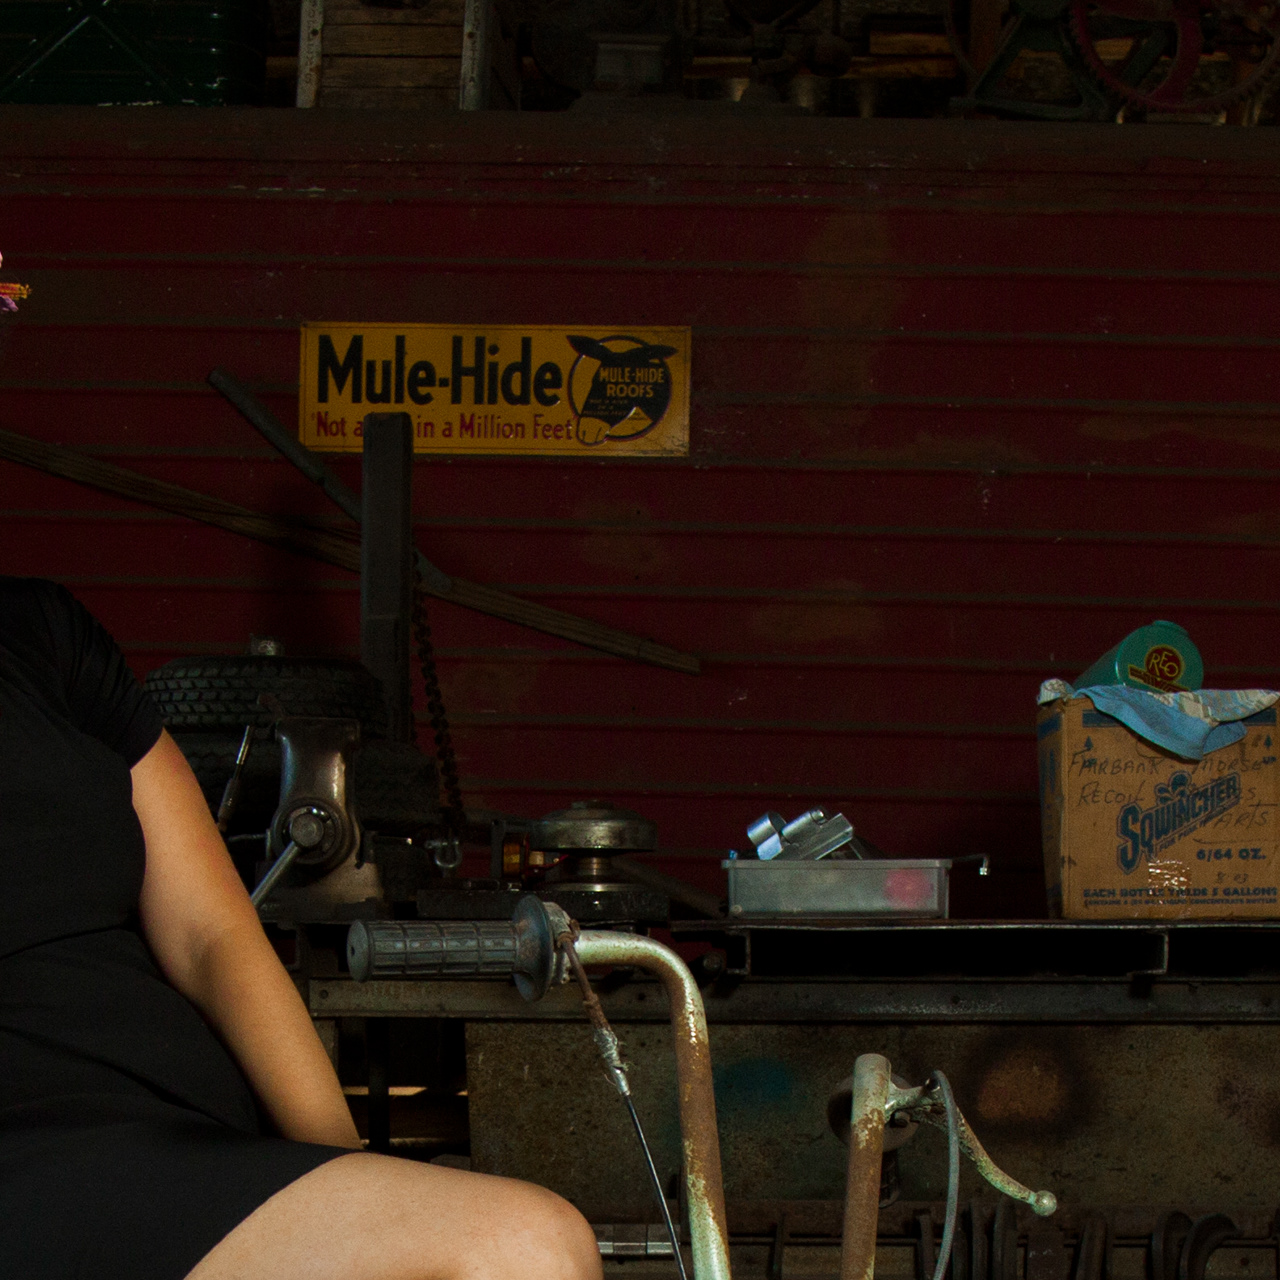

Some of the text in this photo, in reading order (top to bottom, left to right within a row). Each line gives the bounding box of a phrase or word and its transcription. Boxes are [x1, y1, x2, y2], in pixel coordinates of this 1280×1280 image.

[317, 334, 563, 407] Mule-Hide
[599, 366, 665, 384] MULE-HIDE
[606, 383, 654, 398] ROOFS
[416, 415, 434, 438] in
[442, 421, 452, 438] a
[459, 413, 525, 439] Million
[533, 414, 573, 440] Feet
[1147, 650, 1180, 679] REO
[1222, 886, 1278, 897] GALLONS
